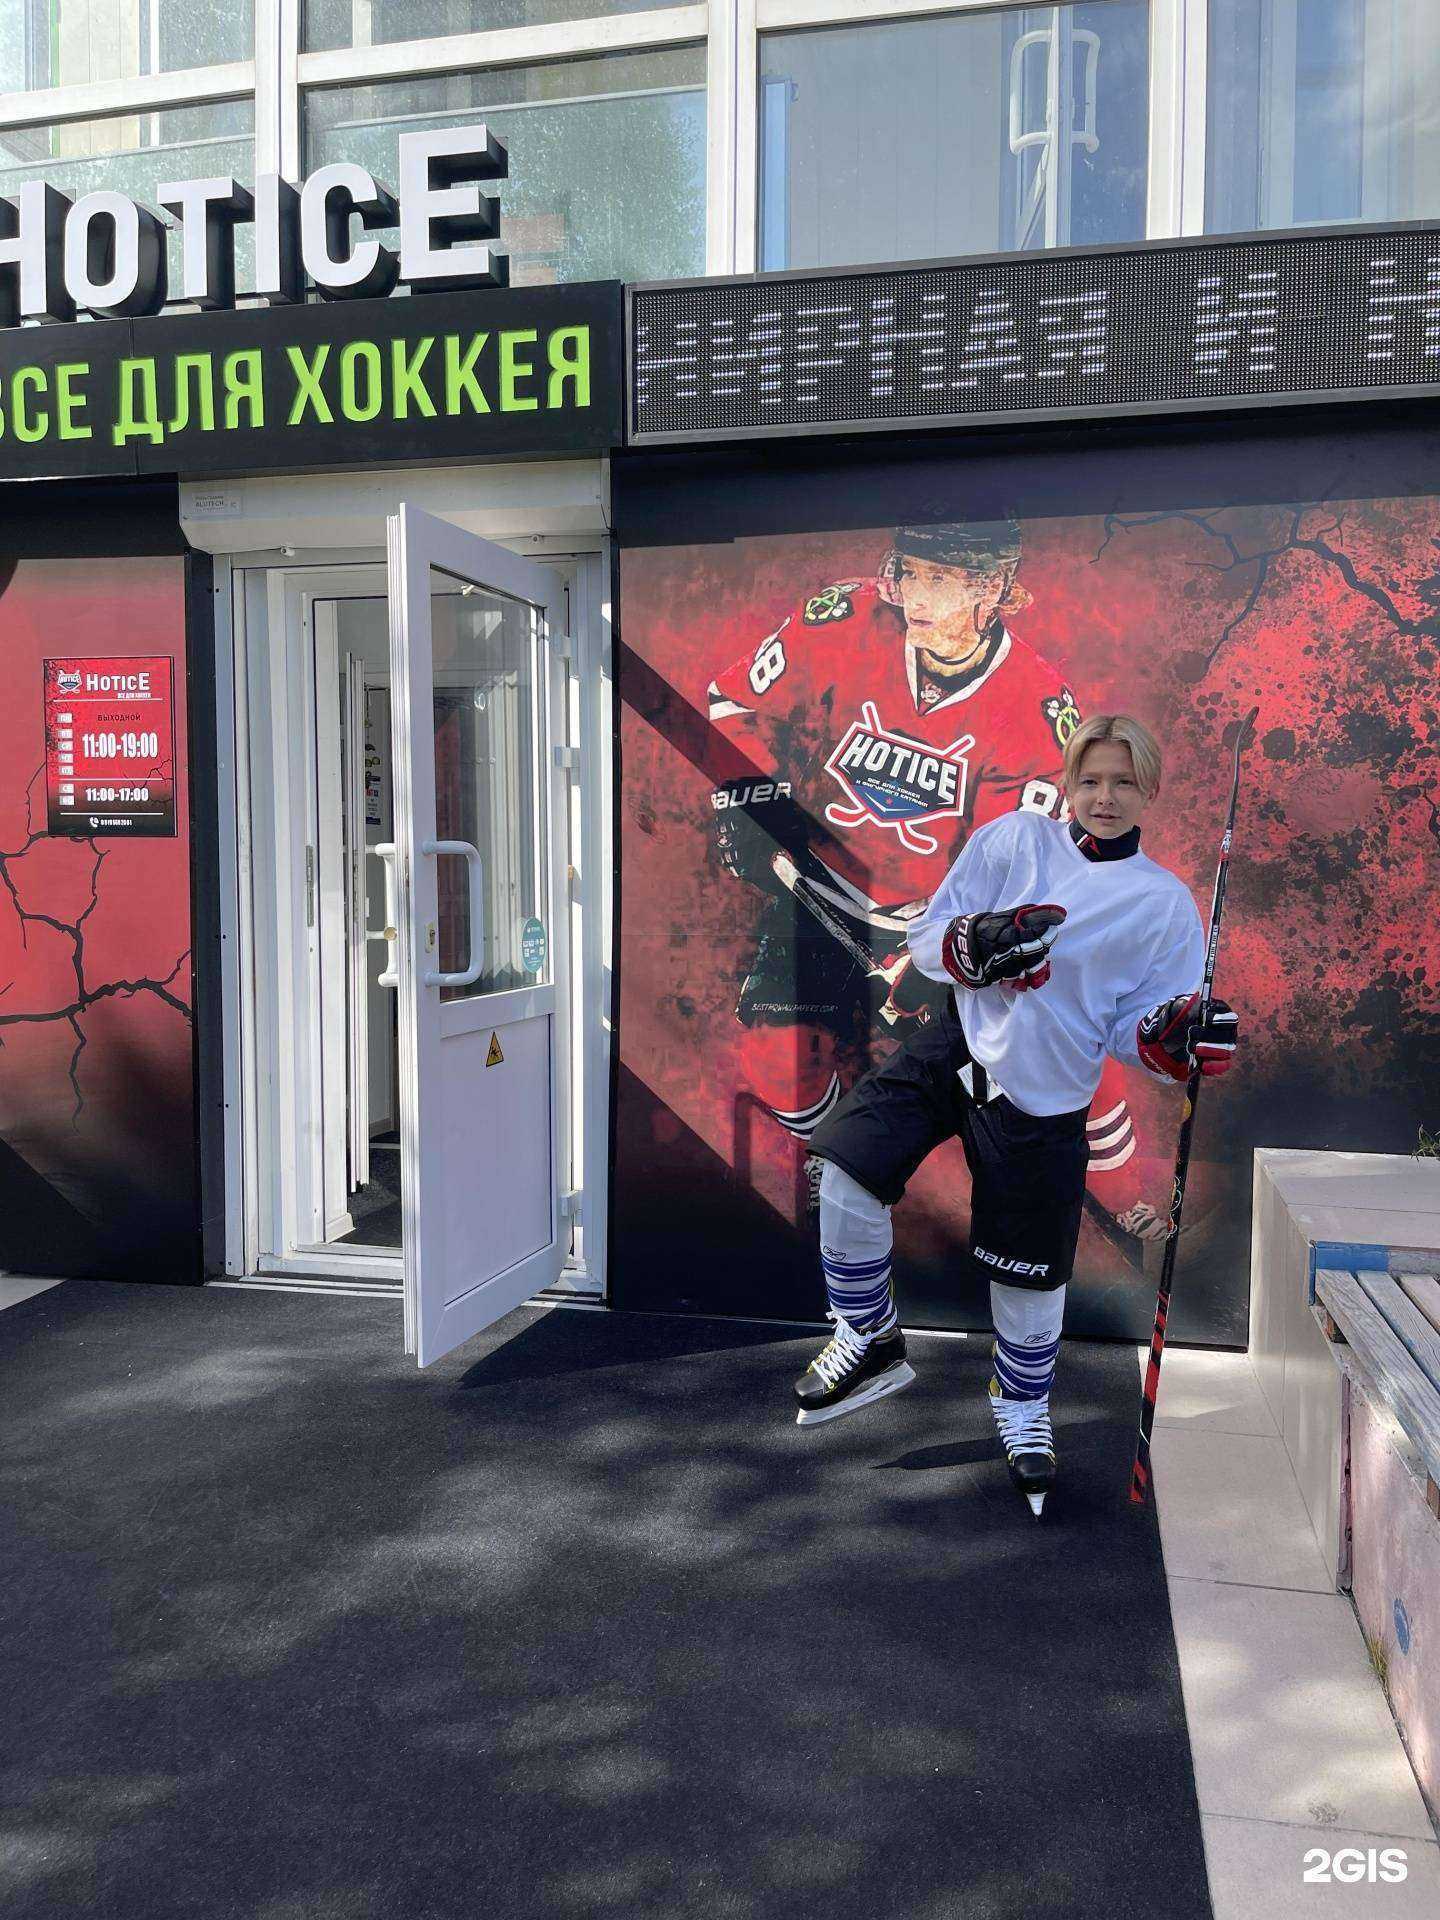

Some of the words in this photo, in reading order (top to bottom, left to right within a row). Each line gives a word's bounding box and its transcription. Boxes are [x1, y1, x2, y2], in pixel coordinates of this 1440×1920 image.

[0, 362, 93, 443] СЕ
[112, 350, 264, 446] ДЛЯ
[287, 325, 590, 426] ХОККЕЯ
[86, 672, 151, 691] HOTICE
[82, 732, 158, 758] 11:00-19:00
[838, 734, 958, 804] HOTICE
[85, 787, 149, 801] 11:00-17:00
